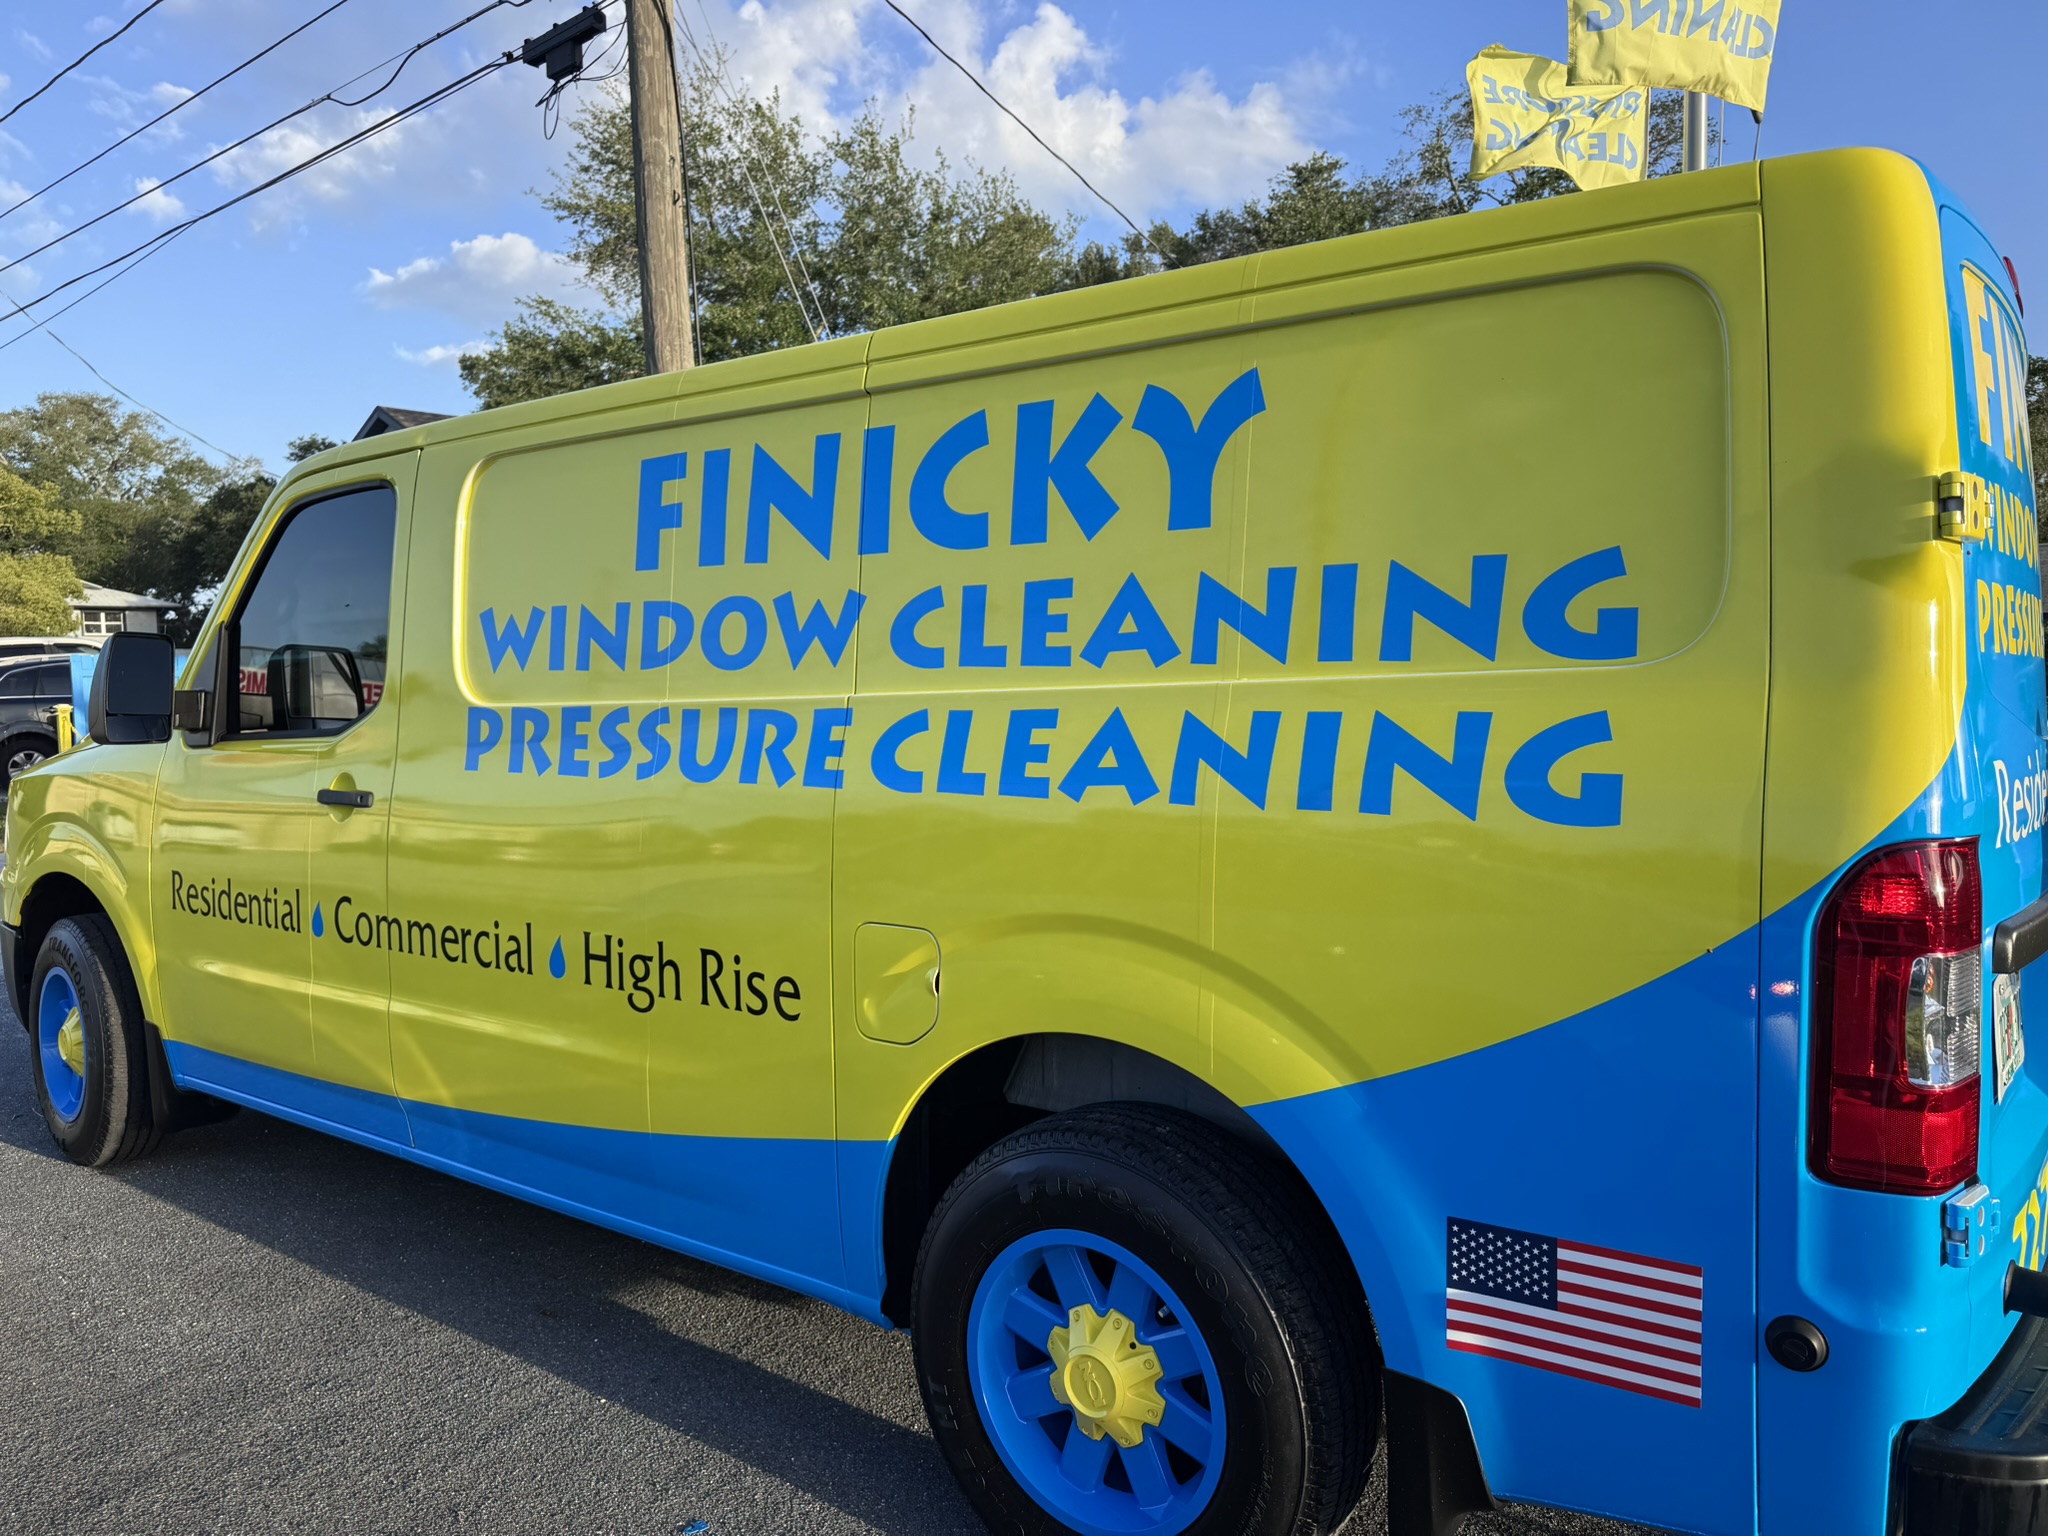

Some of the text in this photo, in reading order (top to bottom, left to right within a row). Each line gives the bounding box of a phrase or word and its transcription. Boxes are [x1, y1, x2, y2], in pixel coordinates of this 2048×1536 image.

[634, 367, 1267, 572] FINICKY
[479, 545, 1640, 674] WINDOW CLEANING
[464, 705, 1624, 828] PRESSURE CLEANING
[170, 869, 802, 1022] Residential Commercial High Rise
